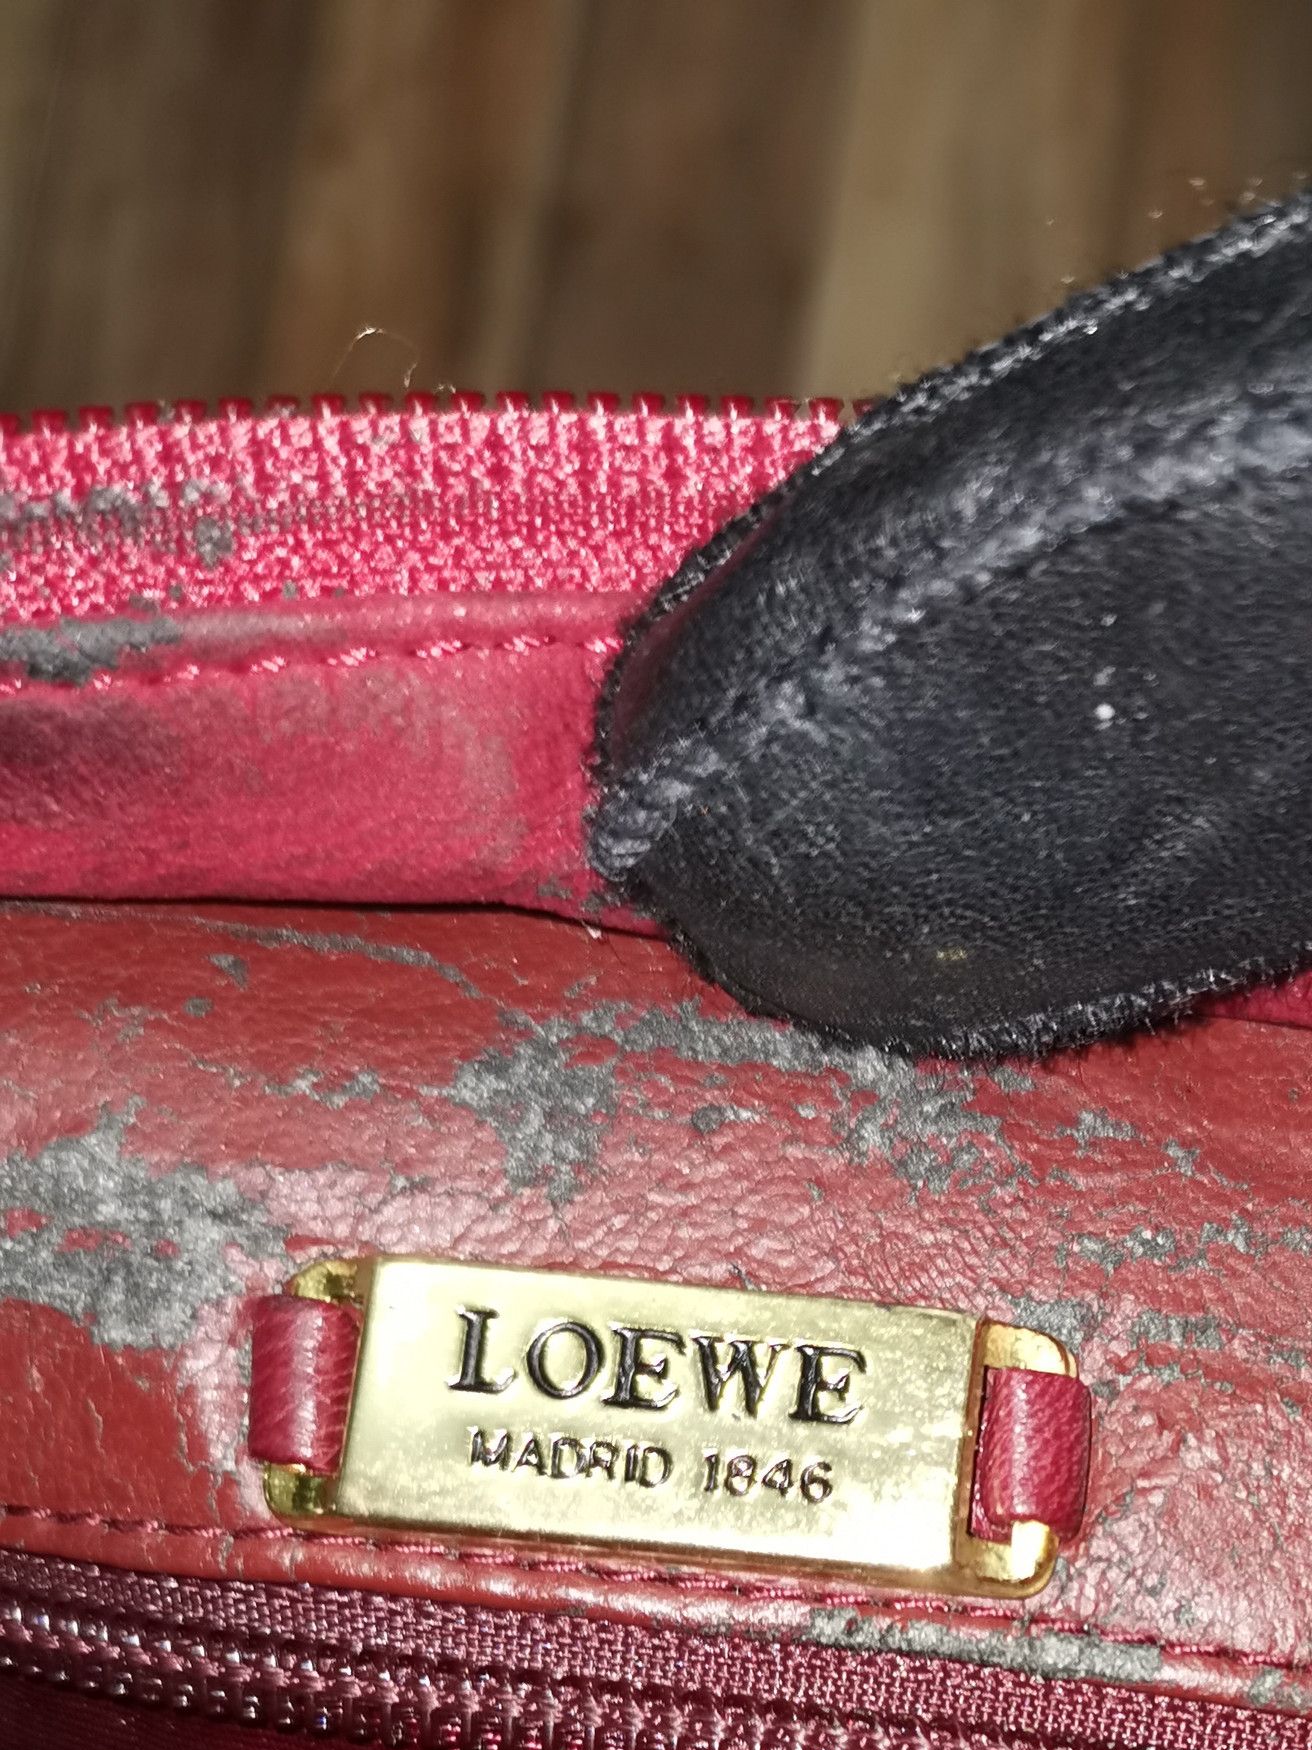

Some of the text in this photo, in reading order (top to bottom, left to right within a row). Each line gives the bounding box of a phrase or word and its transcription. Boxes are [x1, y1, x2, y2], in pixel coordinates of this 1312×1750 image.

[446, 1306, 868, 1425] LOEWE
[470, 1427, 833, 1502] MADRID 1846
